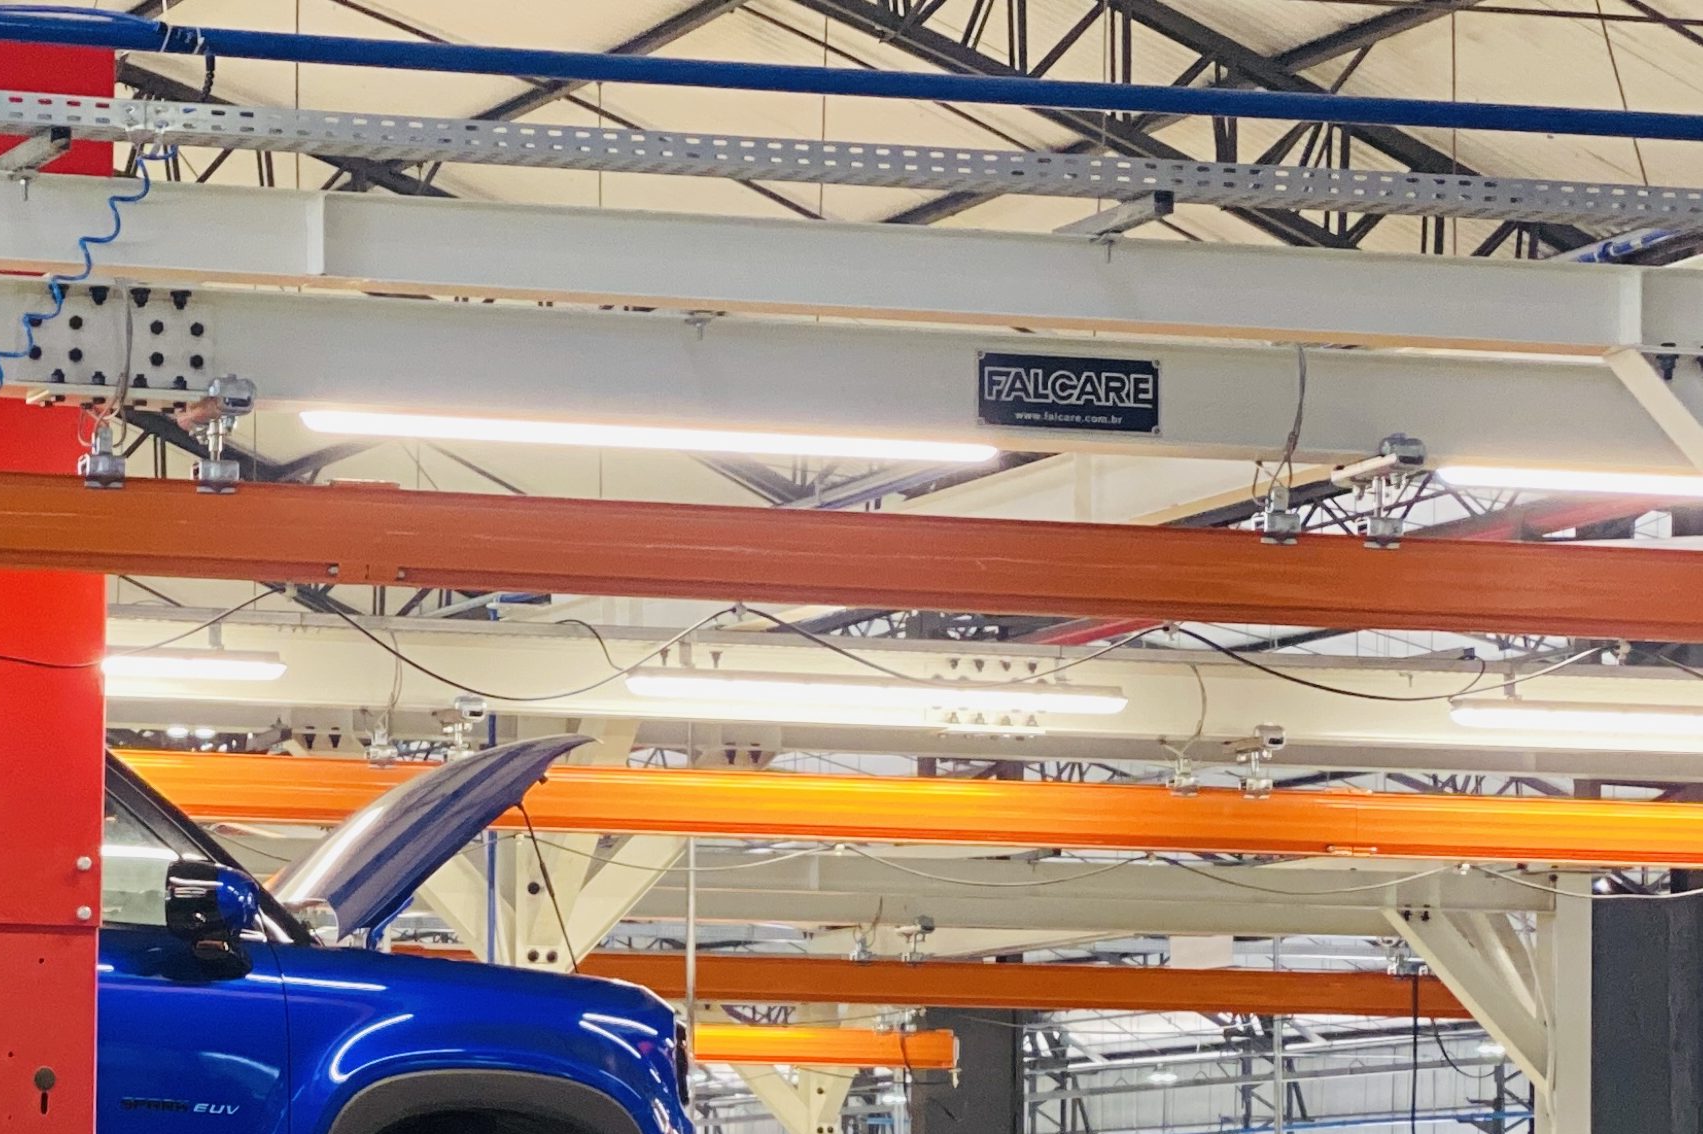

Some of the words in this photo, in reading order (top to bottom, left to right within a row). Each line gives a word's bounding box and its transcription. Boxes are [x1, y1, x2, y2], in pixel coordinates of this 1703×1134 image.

[984, 365, 1154, 409] FALCARE
[1014, 411, 1124, 425] www.falcare.com.br
[193, 1103, 240, 1115] EUV
